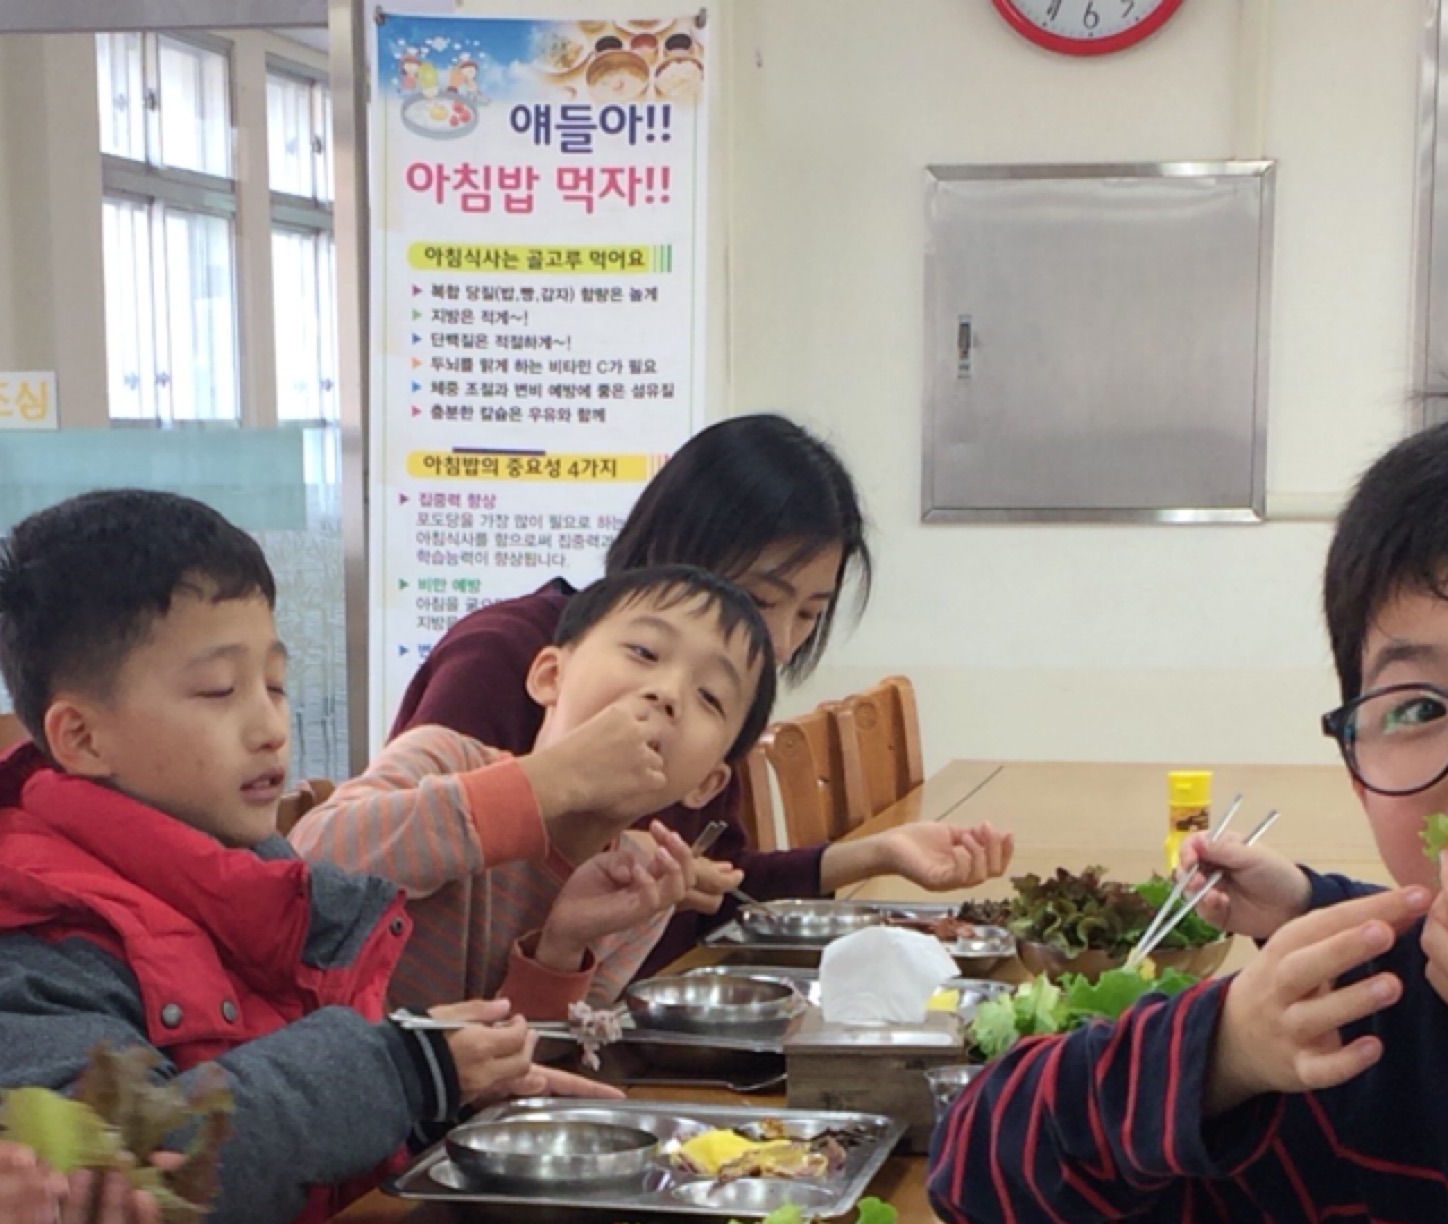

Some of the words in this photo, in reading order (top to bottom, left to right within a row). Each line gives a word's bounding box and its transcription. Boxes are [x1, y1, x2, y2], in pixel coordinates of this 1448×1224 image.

[510, 103, 672, 154] 얘들아!!
[406, 162, 540, 213] 아침밥
[556, 164, 671, 213] 먹자!!
[425, 246, 520, 270] 아침식사는
[526, 247, 582, 270] 골고루
[589, 247, 645, 270] 먹어요
[431, 284, 460, 300] 복합
[580, 286, 623, 303] 함량은
[431, 308, 474, 325] 지방은
[430, 333, 489, 349] 단백질은
[430, 356, 473, 373] 두뇌를
[514, 358, 543, 374] 하는
[549, 358, 591, 375] 비타민
[597, 359, 623, 375] C가
[629, 359, 657, 375] 필요
[430, 380, 459, 397] 체중
[465, 381, 509, 398] 조절과
[514, 382, 543, 398] 변비
[548, 382, 591, 399] 예방에
[630, 382, 675, 399] 섬유질
[430, 404, 473, 421] 충분한
[528, 406, 571, 423] 우유와
[577, 407, 607, 423] 함께
[423, 455, 499, 477] 아침밥의
[506, 456, 561, 479] 중요성
[567, 457, 617, 479] 4가지
[419, 492, 461, 508] 집중력
[467, 493, 497, 510] 향상
[480, 513, 509, 529] 가장
[514, 513, 544, 529] 많이
[415, 531, 487, 547] 아침식사를
